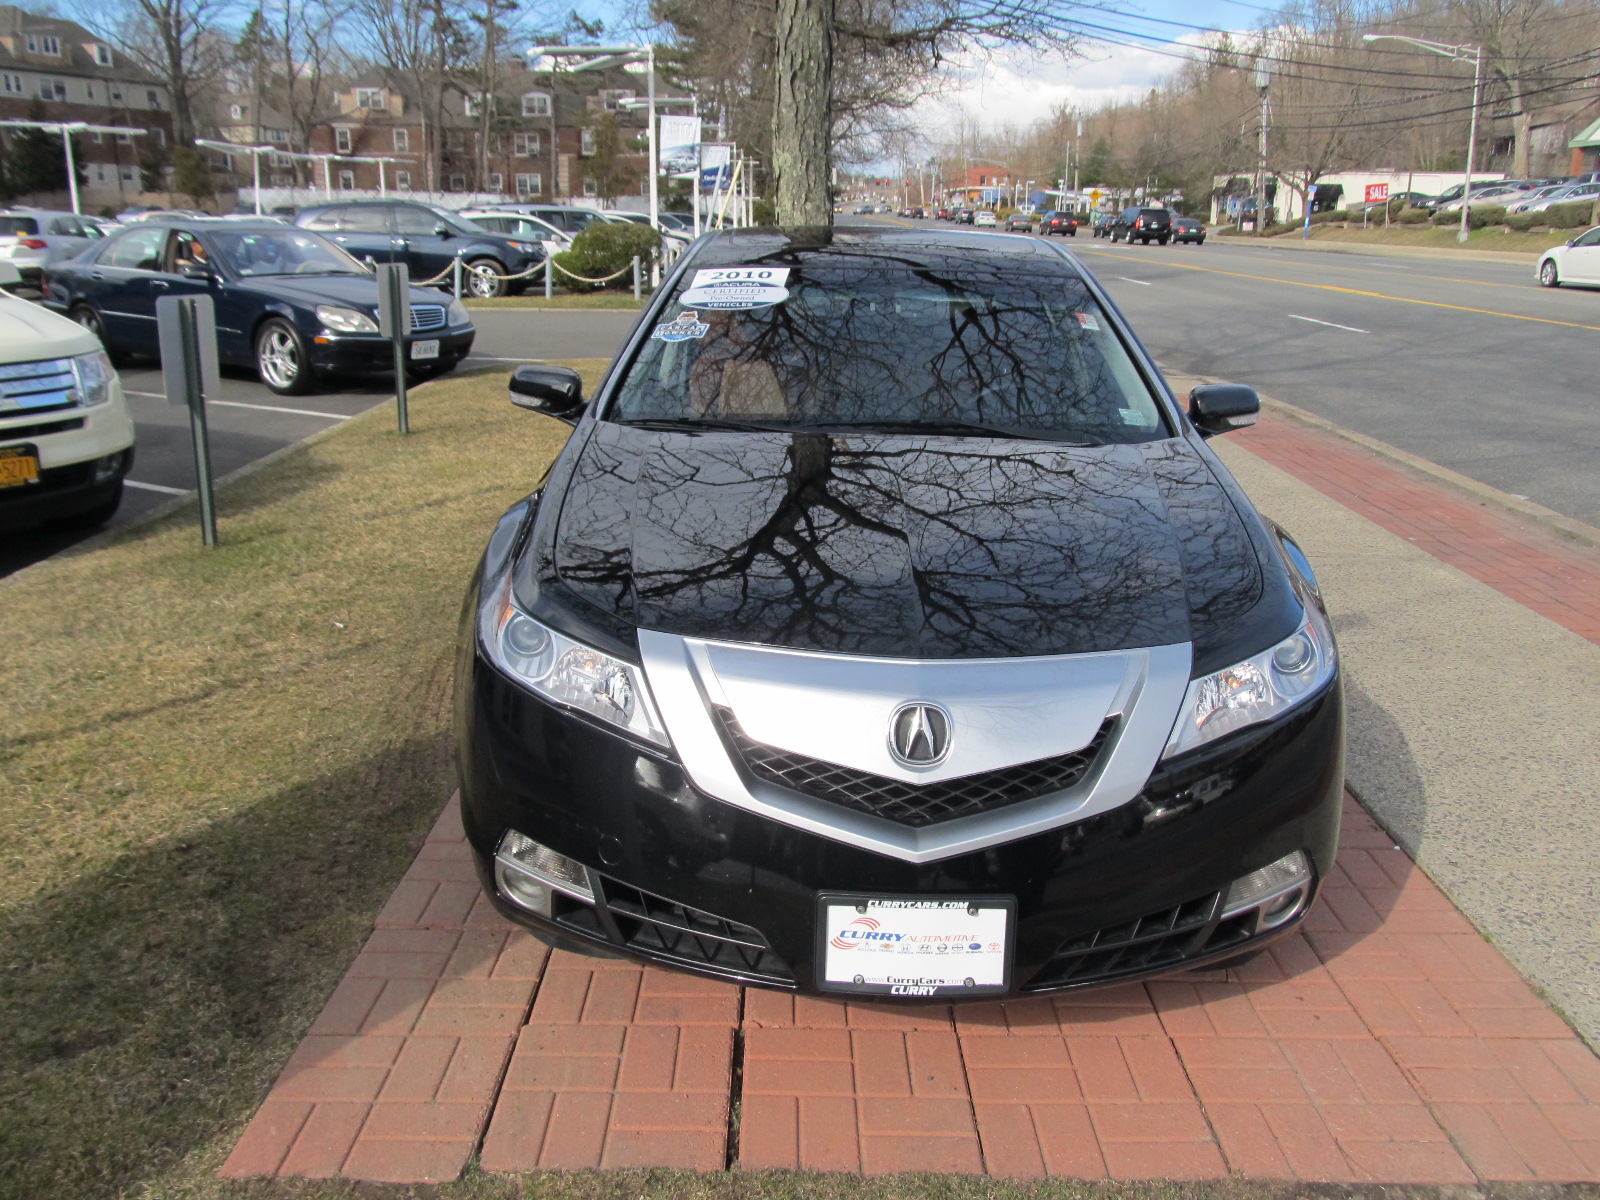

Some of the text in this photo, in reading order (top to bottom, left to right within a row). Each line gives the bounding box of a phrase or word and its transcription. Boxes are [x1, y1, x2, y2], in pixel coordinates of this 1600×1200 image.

[1369, 185, 1388, 200] SALE
[710, 271, 773, 280] 2010
[867, 900, 970, 910] CURRYCARS.COM
[839, 930, 980, 943] CURRY AUTOMOTIVE
[891, 985, 938, 996] CURRY
